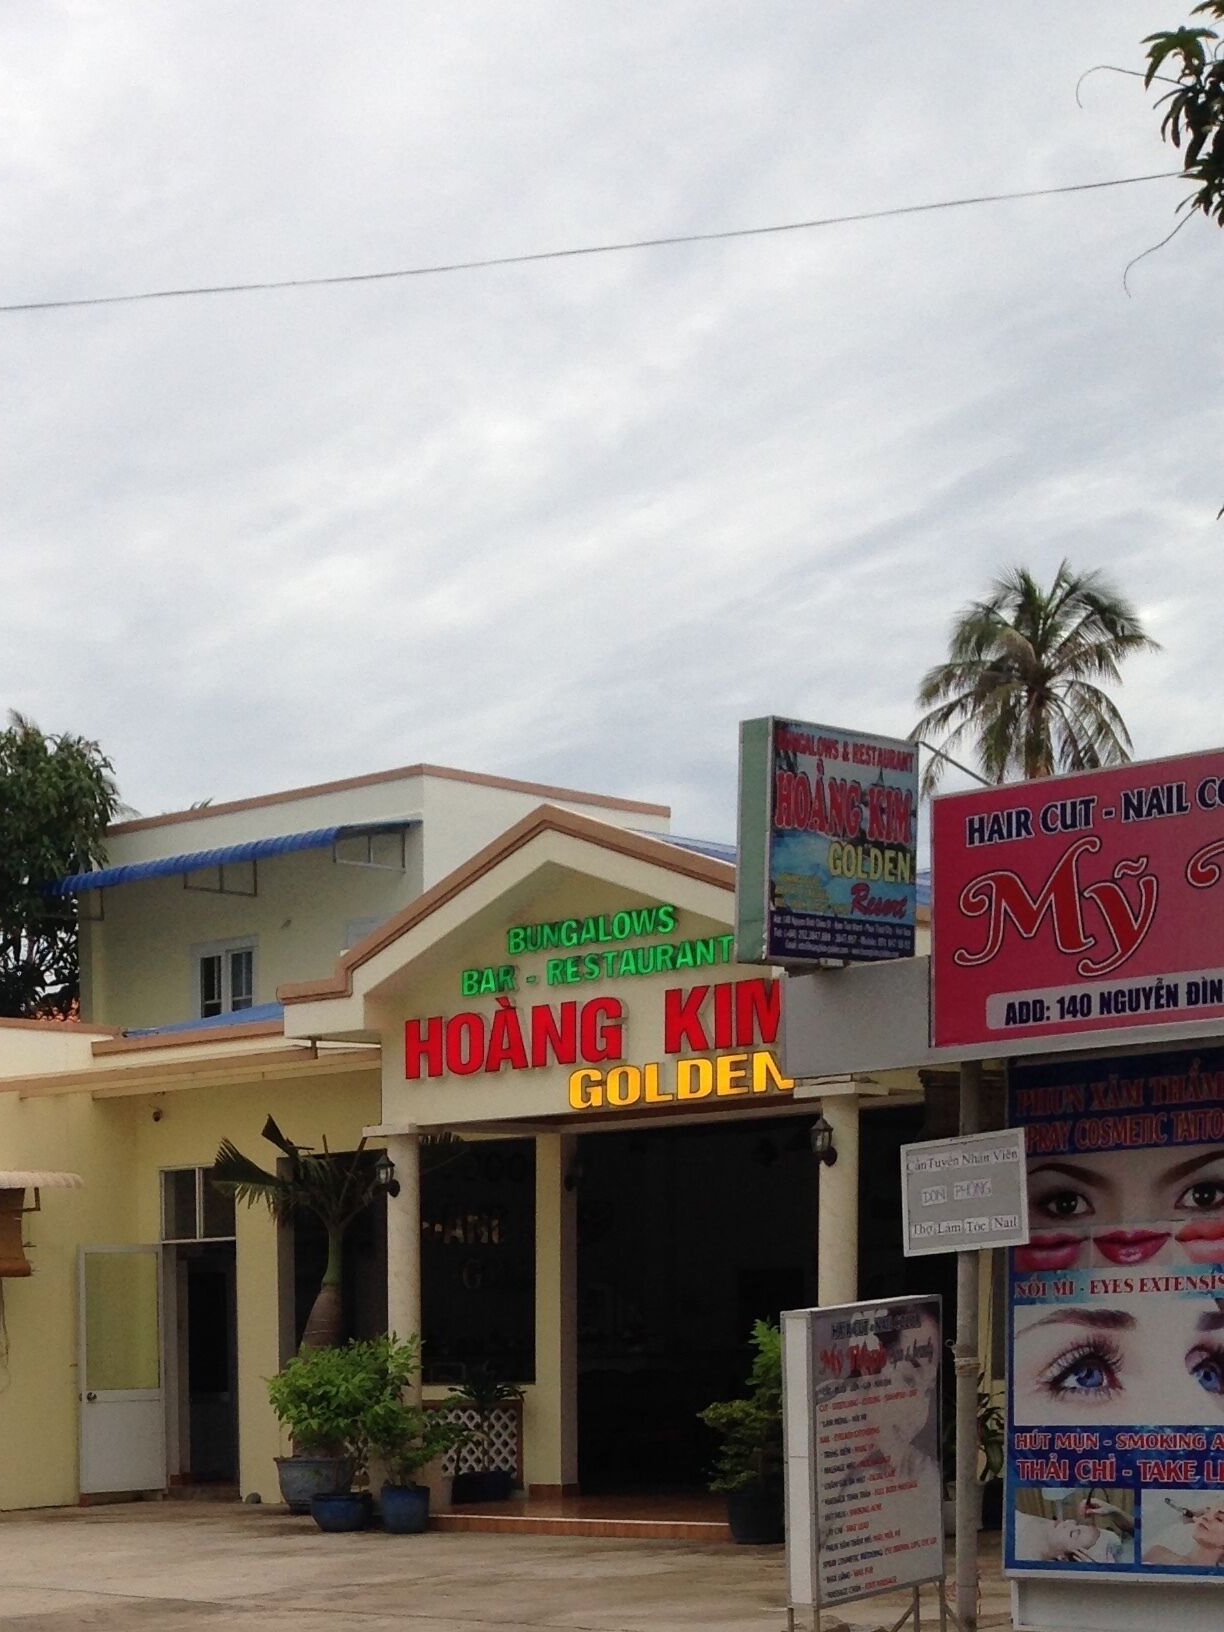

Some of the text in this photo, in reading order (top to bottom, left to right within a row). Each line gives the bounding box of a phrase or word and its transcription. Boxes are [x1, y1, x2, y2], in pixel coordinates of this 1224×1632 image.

[853, 742, 915, 773] RESTAURANT
[867, 785, 912, 844] KIM
[966, 806, 1035, 847] HAIR
[1040, 796, 1097, 834] CUT
[1121, 781, 1190, 824] NAIL
[828, 842, 913, 884] GOLDEN
[507, 904, 678, 957] BUNGALOWS
[953, 836, 1159, 978] Mỹ
[461, 964, 519, 998] BAR
[546, 934, 734, 988] RESTAURANT
[1005, 999, 1051, 1026] ADD:
[1056, 992, 1092, 1020] 140
[1099, 977, 1179, 1015] NGUYỄN
[405, 996, 625, 1081] HOÀNG
[568, 1050, 795, 1111] GOLDEN
[1074, 1113, 1168, 1149] COSMETIC
[1089, 1277, 1134, 1295] EYES
[1015, 1430, 1051, 1450] HÚT
[1054, 1432, 1099, 1455] MỤN
[1115, 1432, 1206, 1450] SMOKING
[1137, 1459, 1199, 1482] TAKE
